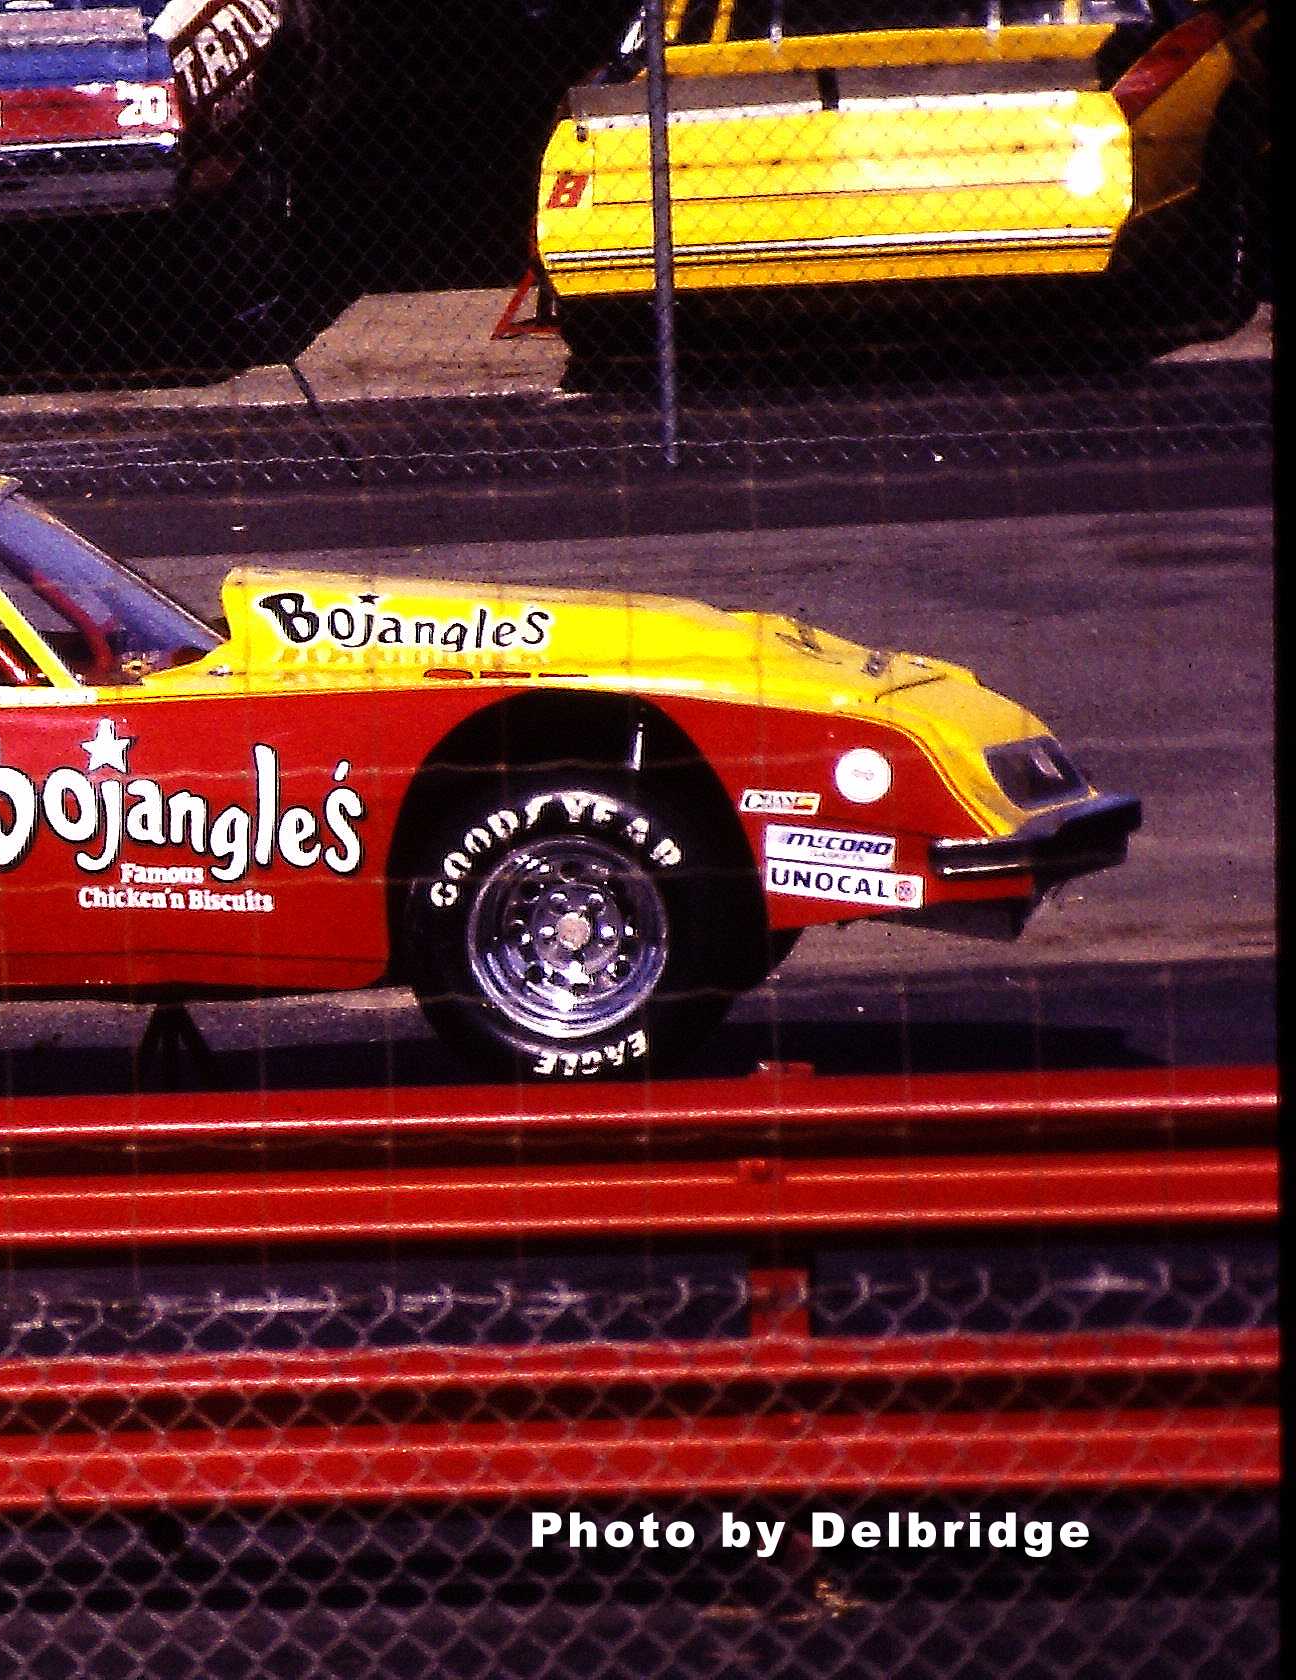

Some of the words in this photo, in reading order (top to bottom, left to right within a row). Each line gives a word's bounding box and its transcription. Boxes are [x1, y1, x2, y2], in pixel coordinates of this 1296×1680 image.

[114, 81, 170, 126] 20
[120, 863, 205, 884] Famous
[771, 867, 890, 898] UNOCAL
[188, 889, 275, 912] Biscuits
